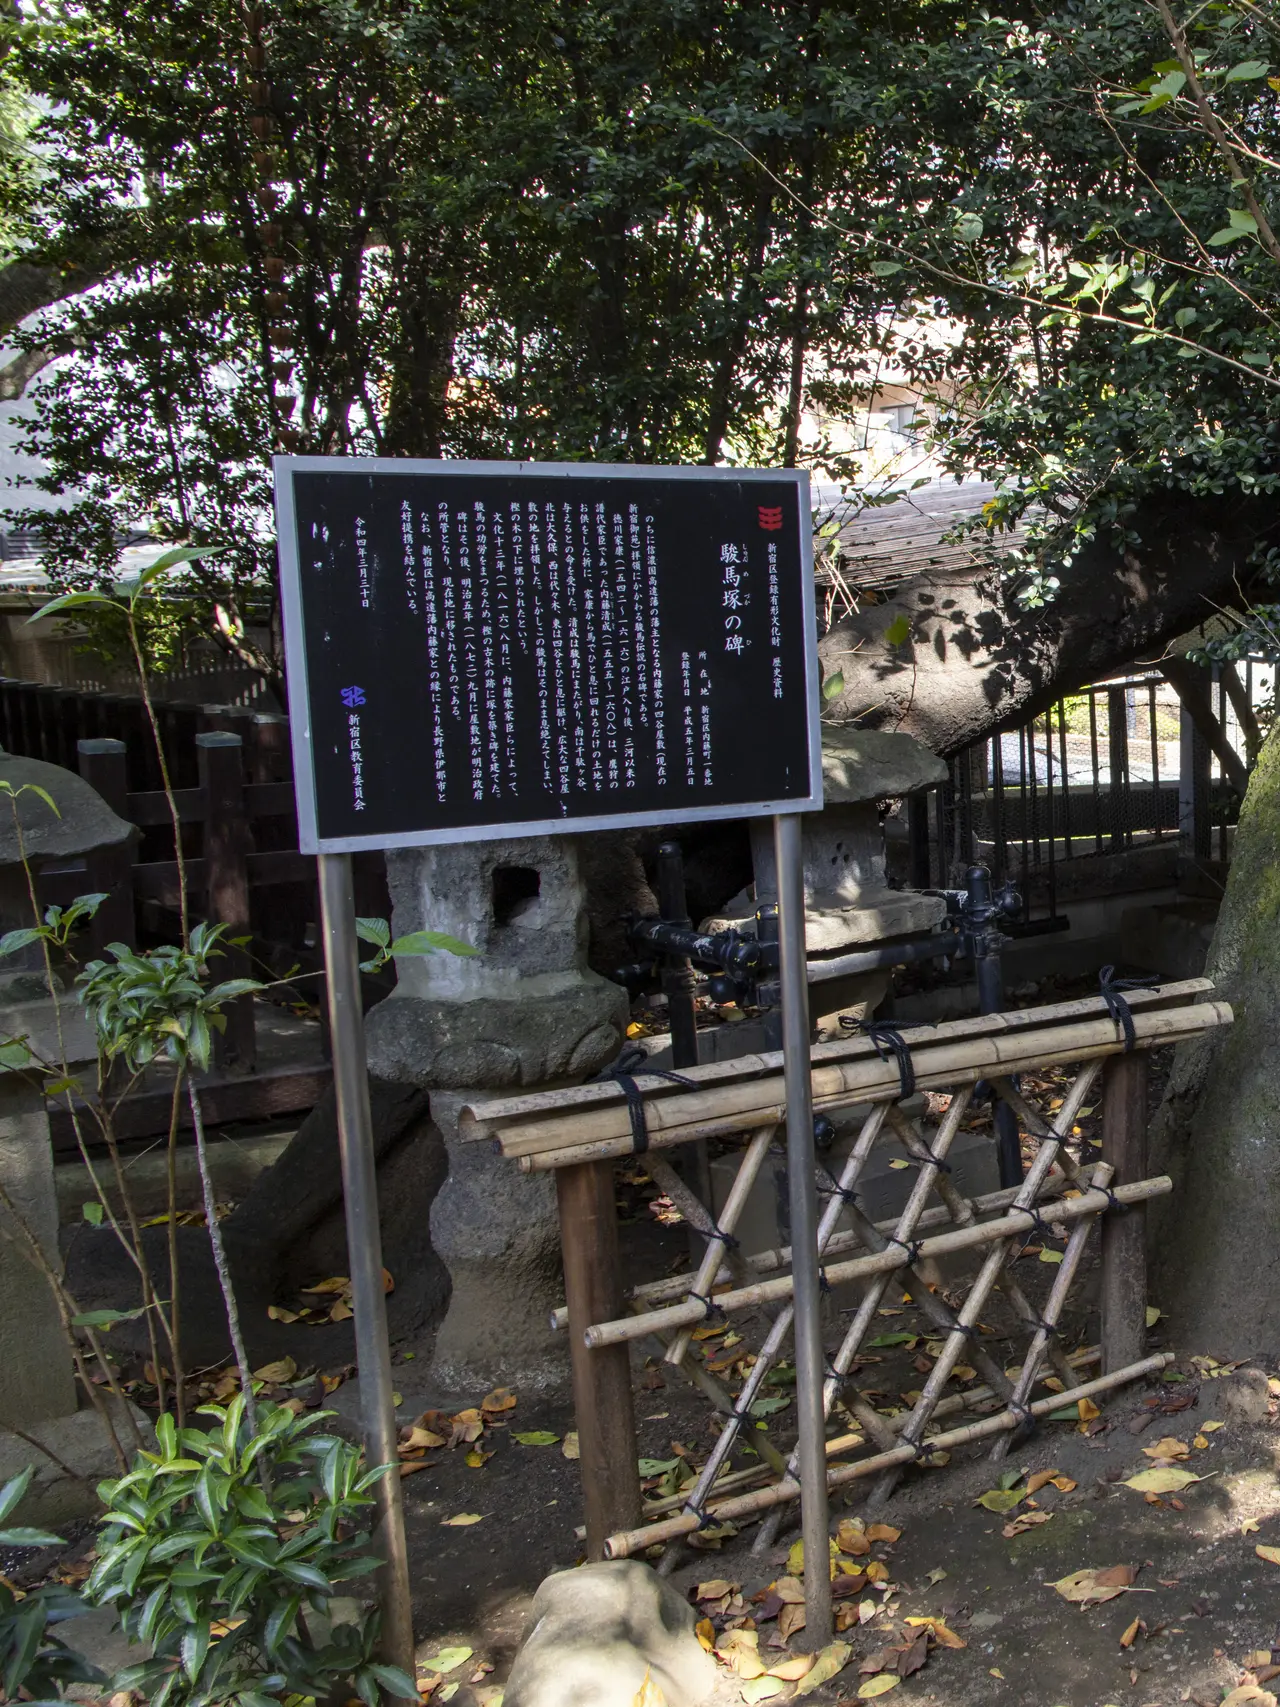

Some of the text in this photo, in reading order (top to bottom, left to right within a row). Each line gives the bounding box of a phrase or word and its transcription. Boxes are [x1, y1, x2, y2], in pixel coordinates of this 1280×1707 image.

[355, 517, 370, 607] 令和四年三月三十日
[720, 543, 744, 655] 駿馬塚の碑
[768, 543, 782, 698] 新宿区登録有形文化財 歴史資料
[348, 714, 366, 810] 新宿区教育委員会
[682, 652, 695, 784] 登録年月日 平成五年三月五日
